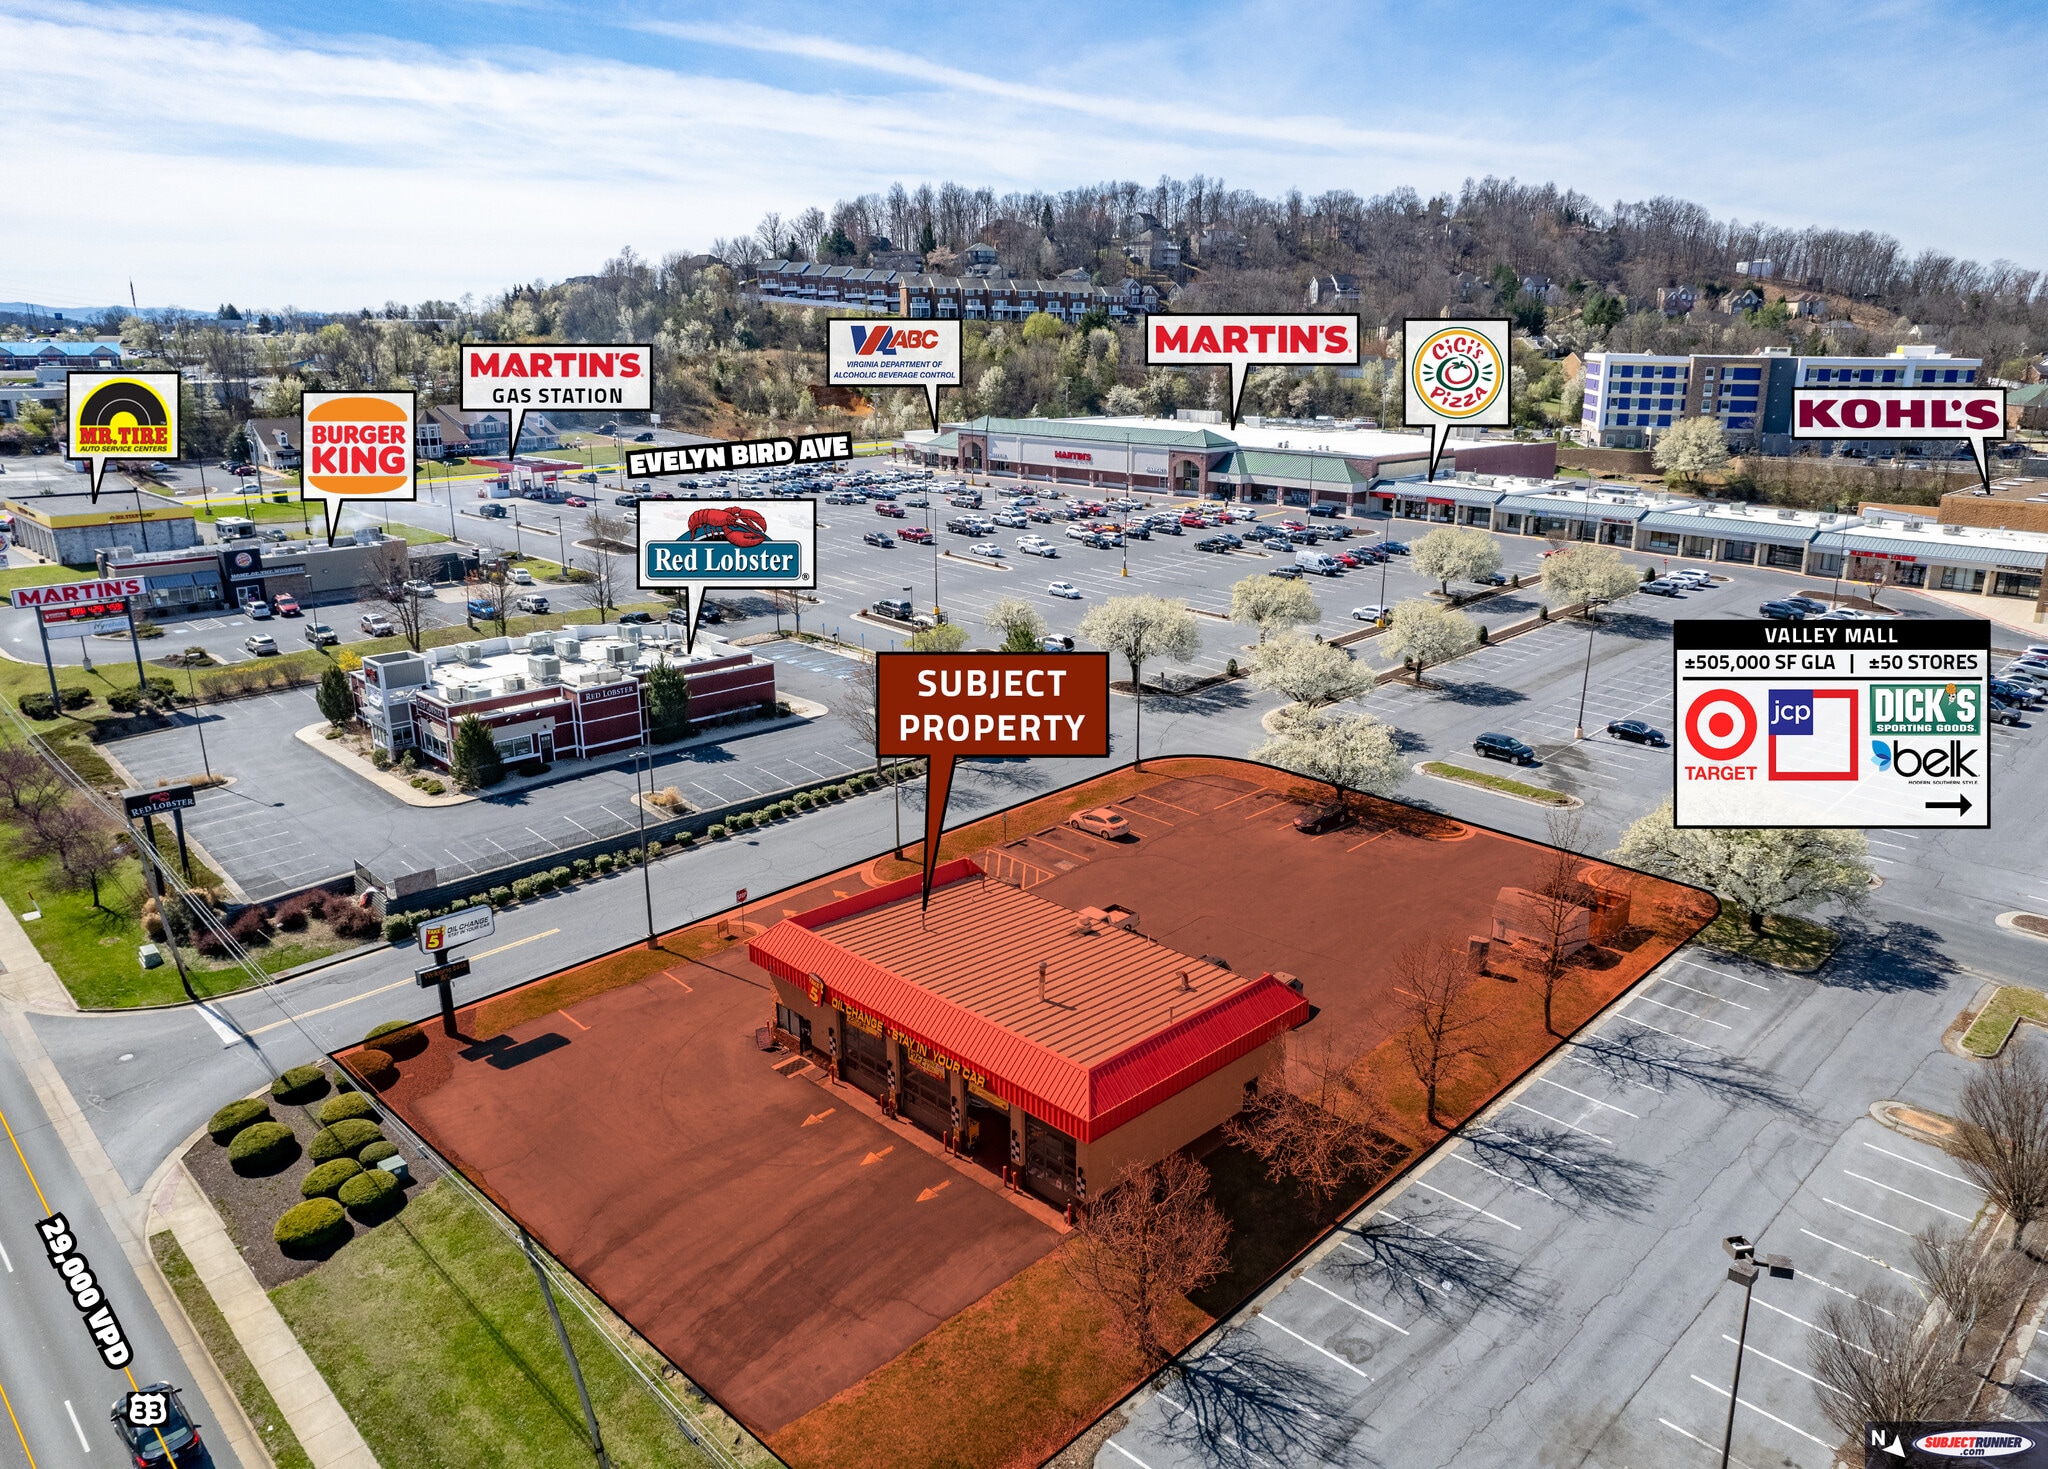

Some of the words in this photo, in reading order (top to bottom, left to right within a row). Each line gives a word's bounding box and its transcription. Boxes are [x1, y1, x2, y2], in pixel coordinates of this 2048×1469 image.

[18, 580, 140, 606] MARTIN'S
[602, 686, 634, 698] LOBSTER
[131, 805, 152, 817] RED
[152, 798, 194, 811] LOBSTER
[447, 925, 458, 933] OIL
[459, 916, 489, 929] CHANGE
[427, 935, 440, 948] 5
[809, 986, 818, 1003] 5
[832, 997, 845, 1013] OIL
[846, 1006, 884, 1033] CHANGE
[892, 1030, 915, 1048] STAY
[916, 1043, 928, 1057] IN
[933, 1050, 961, 1075] YOUR
[962, 1068, 986, 1088] CAR
